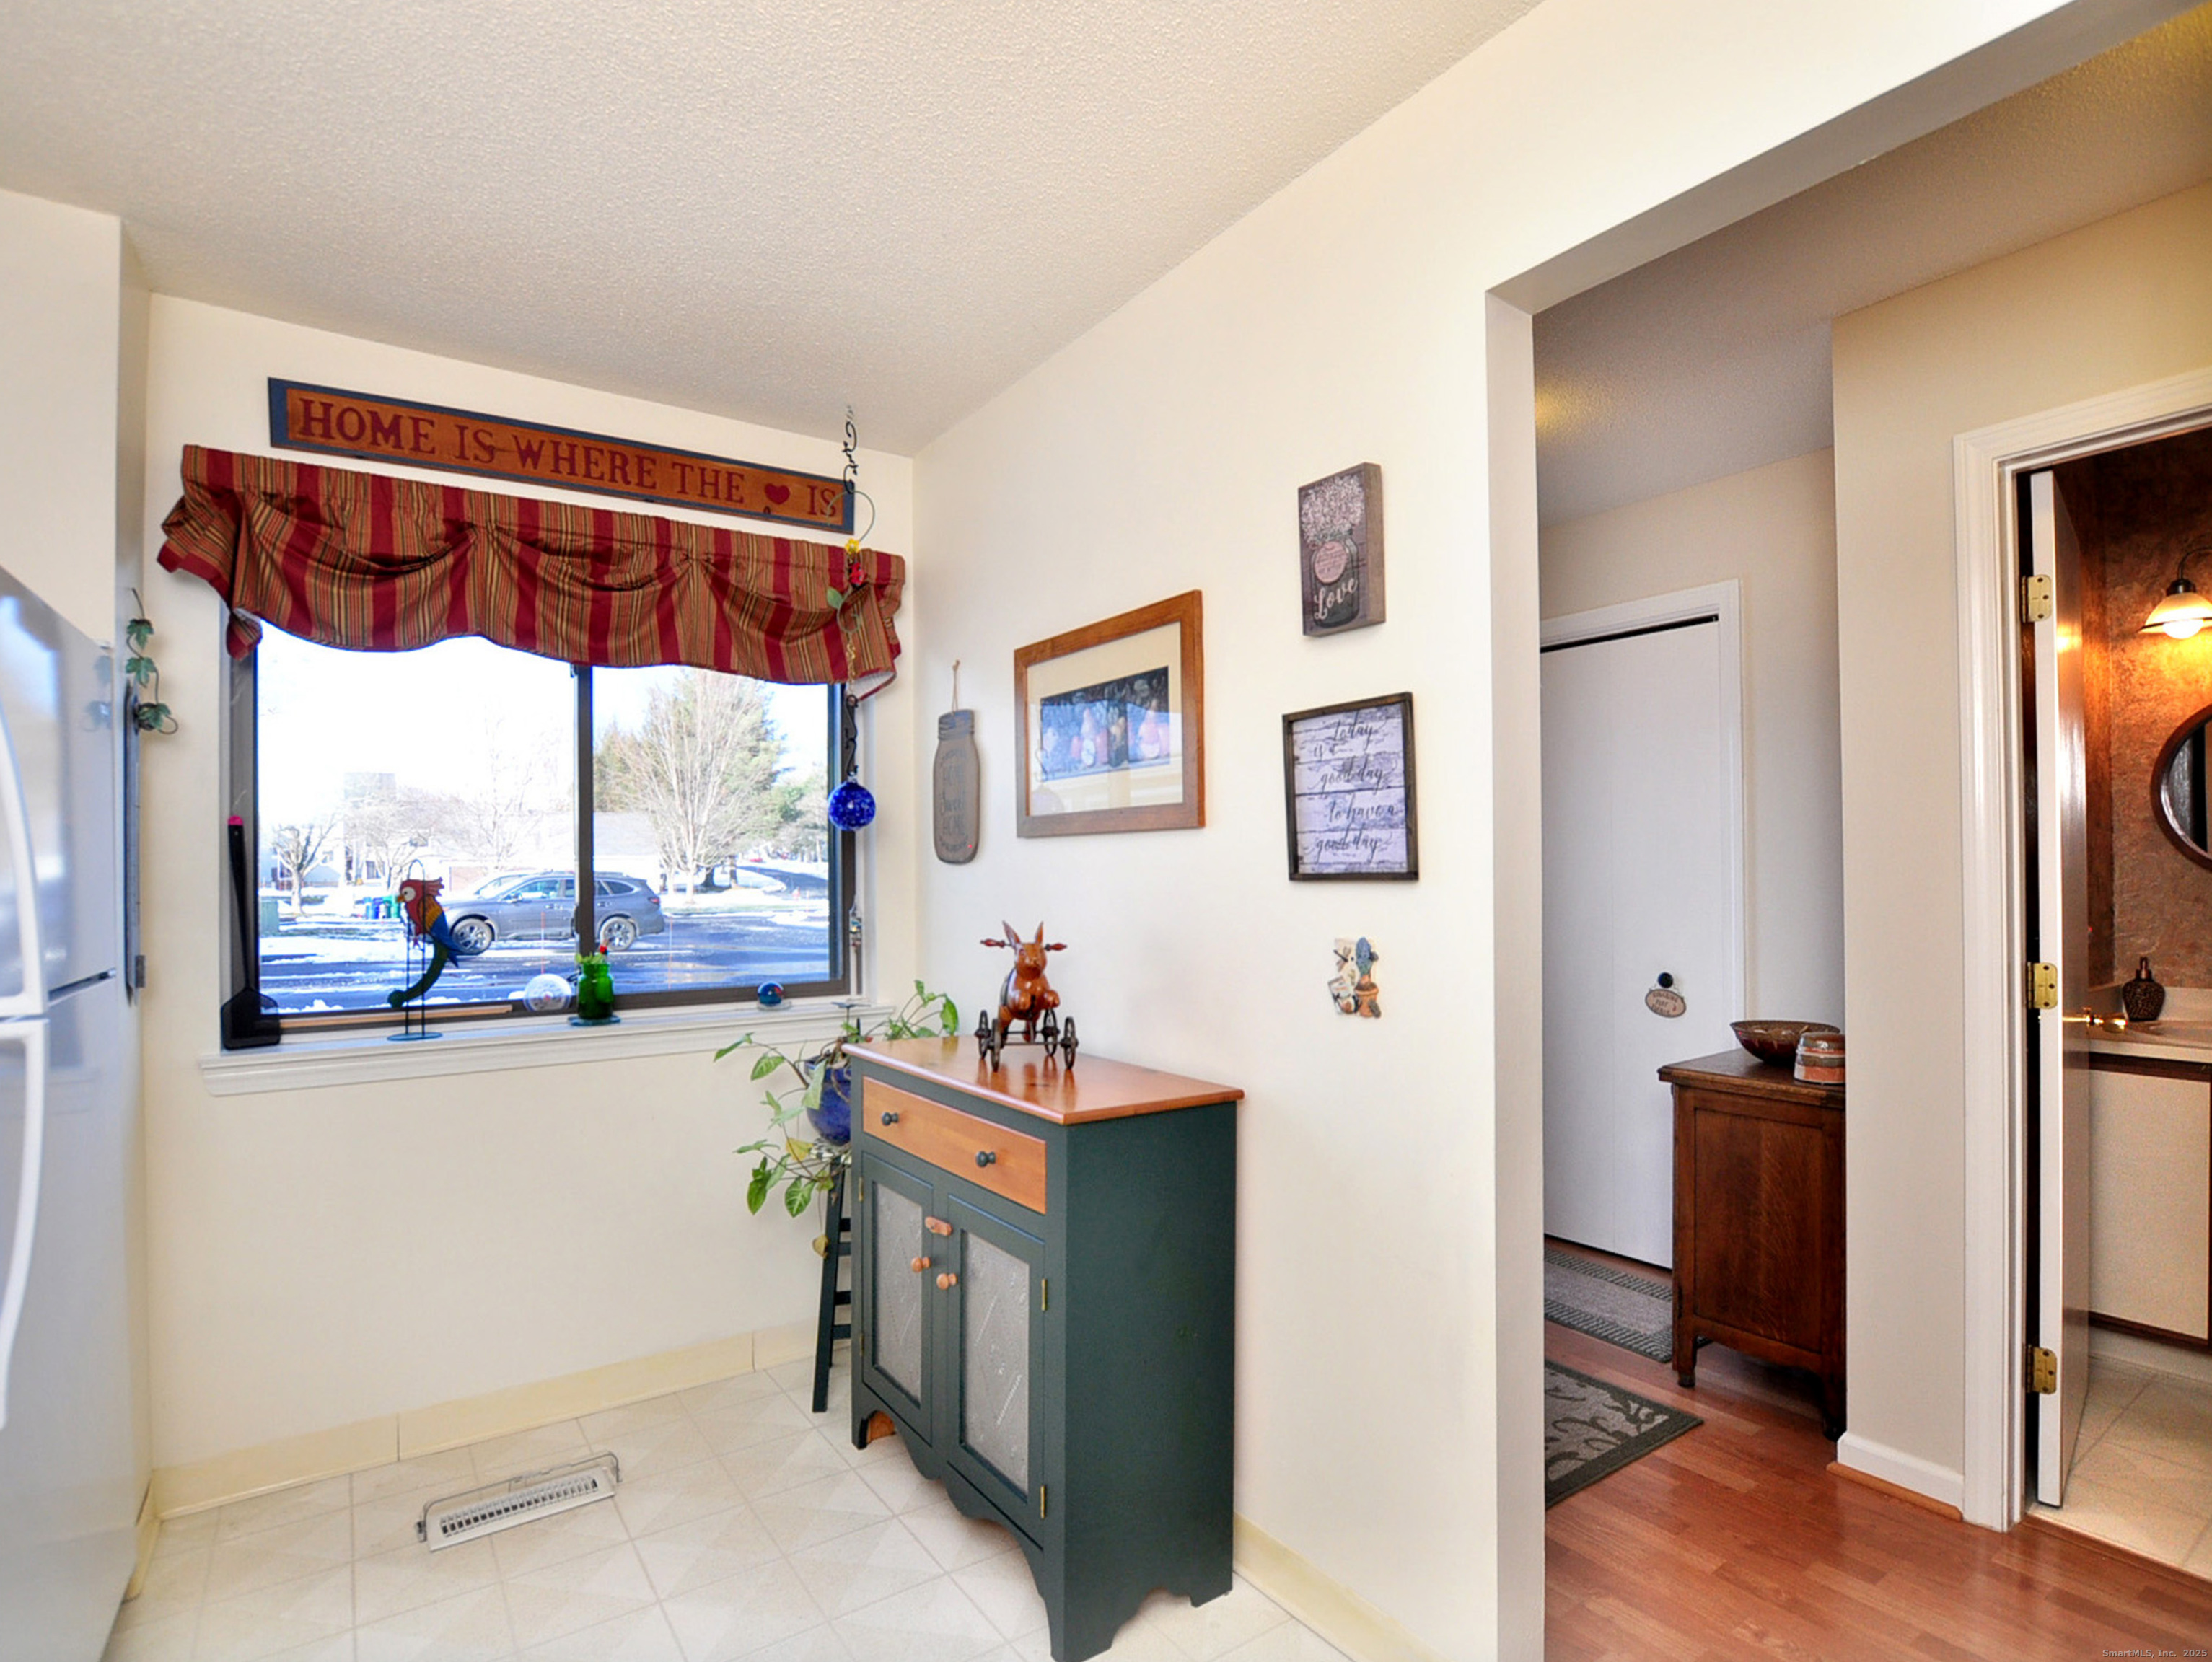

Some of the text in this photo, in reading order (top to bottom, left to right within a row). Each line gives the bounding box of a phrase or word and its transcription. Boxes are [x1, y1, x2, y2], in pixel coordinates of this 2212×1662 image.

[297, 397, 836, 517] HOME IS WHERE THE IS
[1314, 578, 1357, 620] Love
[1316, 754, 1384, 795] good day
[1346, 793, 1382, 823] have
[1316, 824, 1381, 864] good day
